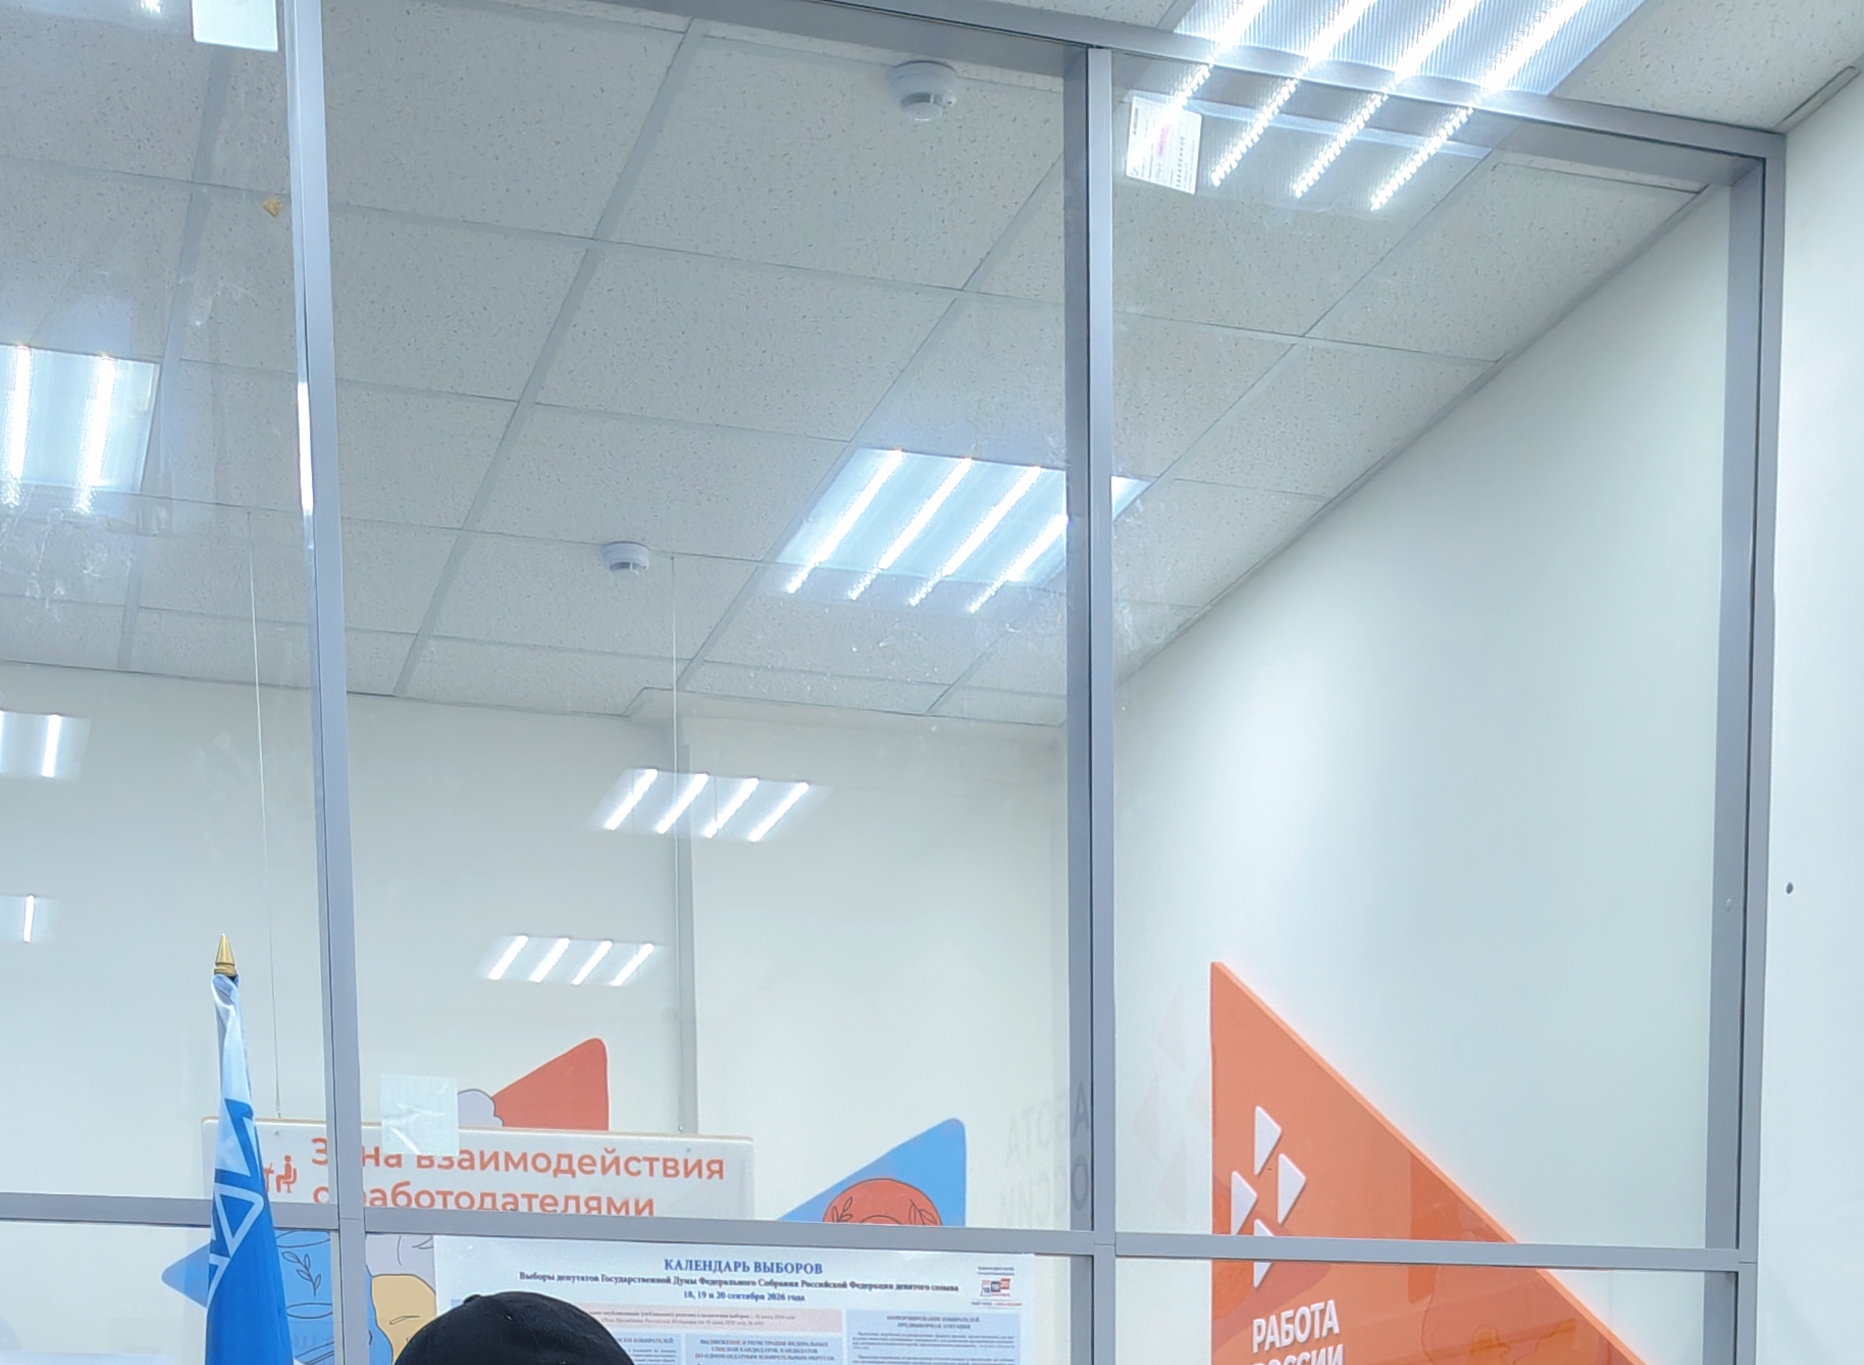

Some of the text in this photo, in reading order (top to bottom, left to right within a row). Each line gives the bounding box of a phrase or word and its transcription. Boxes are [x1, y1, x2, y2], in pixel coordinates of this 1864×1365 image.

[312, 1137, 725, 1181] Зна взаимодействия
[364, 1180, 654, 1218] аботодателями
[519, 1271, 555, 1282] Выборы
[556, 1274, 599, 1283] депутатов
[601, 1274, 671, 1285] Государственной
[673, 1276, 697, 1286] Думы
[698, 1277, 756, 1287] Федерального
[758, 1279, 798, 1288] Собрания
[801, 1280, 847, 1289] Российской
[849, 1281, 894, 1291] Федерации
[664, 1259, 823, 1275] КАЛЕНДАРЬ ВЫБОРОВ
[683, 1291, 695, 1300] 18,
[698, 1291, 706, 1299] 19
[716, 1292, 726, 1300] 20
[727, 1293, 765, 1302] сентября
[787, 1295, 805, 1303] года
[1252, 1299, 1339, 1353] РАБОТА
